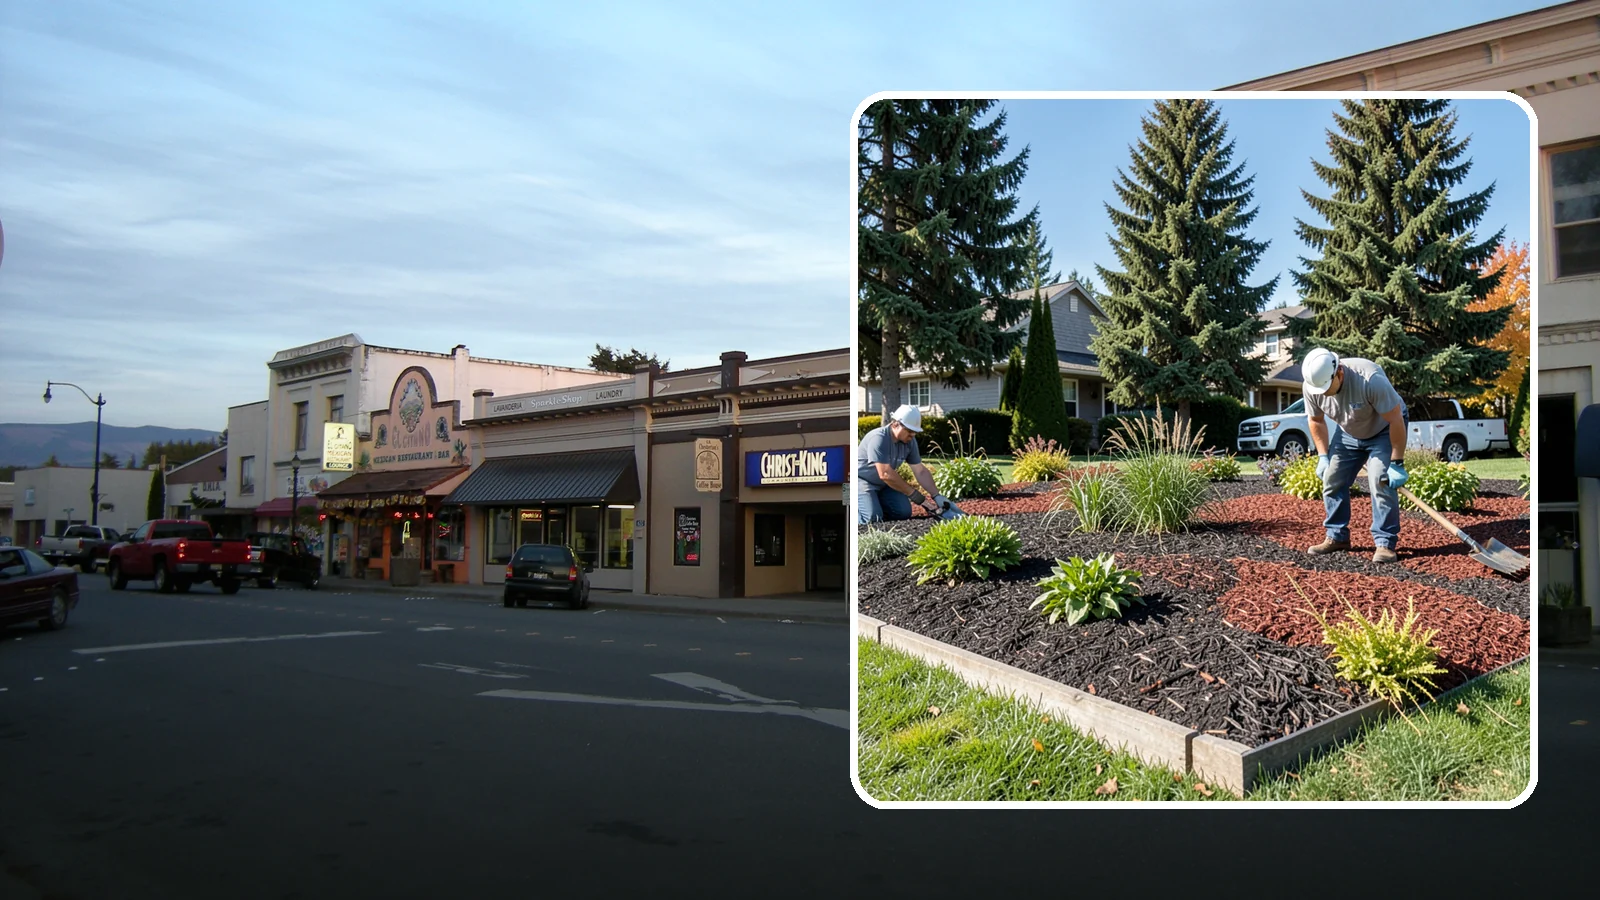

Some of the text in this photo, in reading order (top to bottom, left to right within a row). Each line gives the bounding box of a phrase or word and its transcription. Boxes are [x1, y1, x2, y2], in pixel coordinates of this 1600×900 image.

[561, 394, 582, 404] Shop
[595, 389, 623, 400] LAUNDRY
[493, 401, 522, 412] LAVANDERIA
[373, 454, 396, 464] MEXICAN
[397, 451, 434, 462] RESTAURANT
[438, 450, 450, 459] BAR
[761, 449, 828, 478] CHRIST KING
